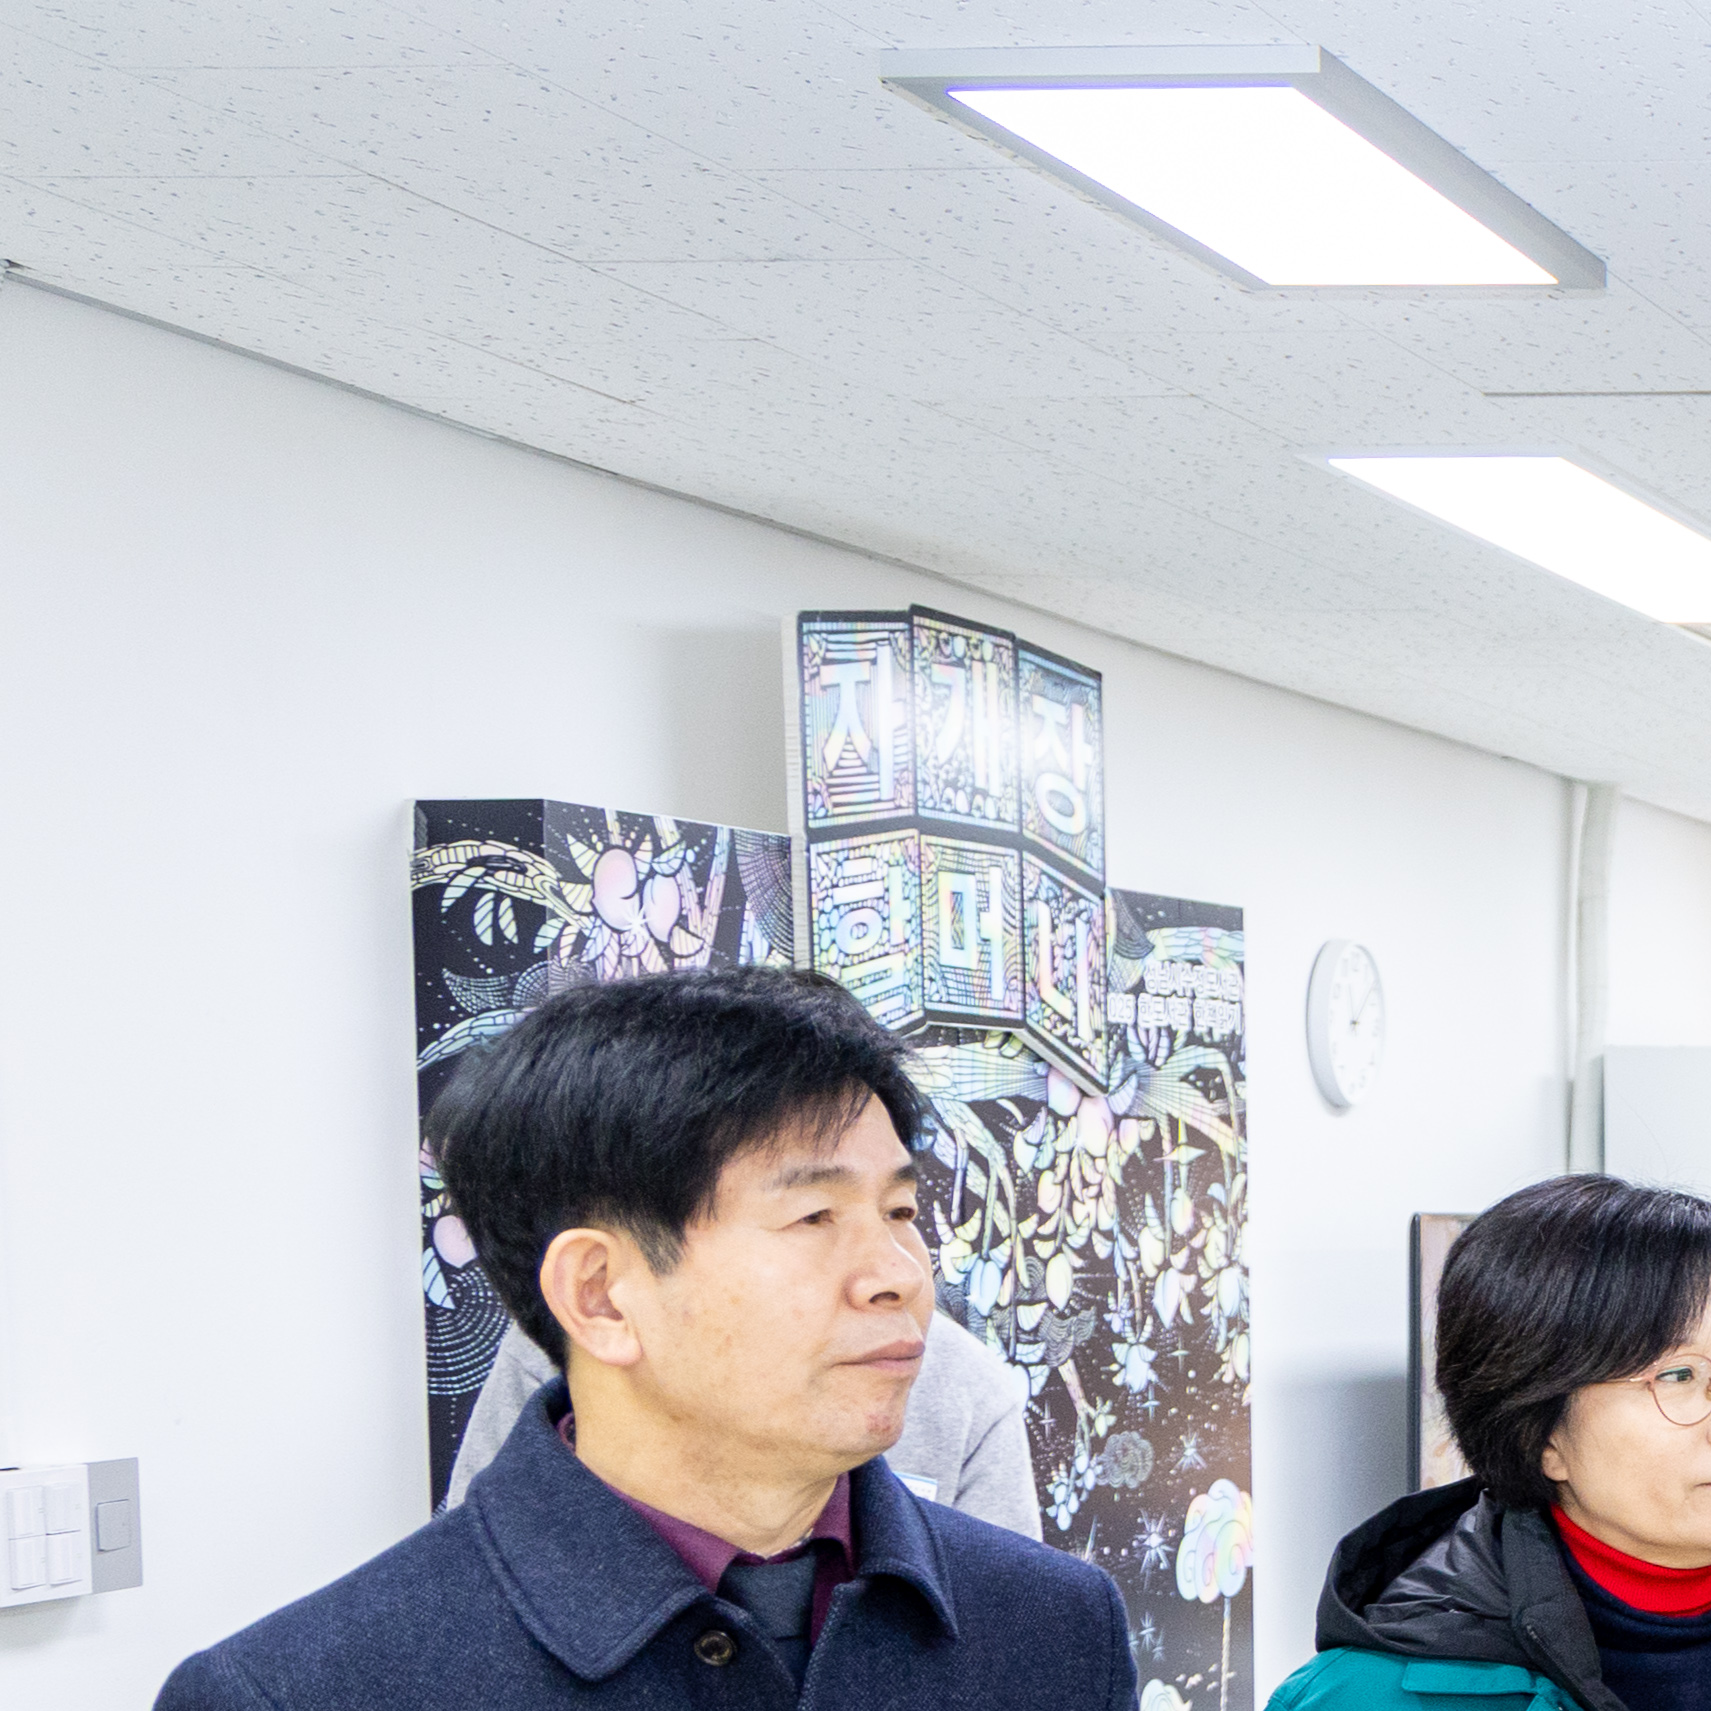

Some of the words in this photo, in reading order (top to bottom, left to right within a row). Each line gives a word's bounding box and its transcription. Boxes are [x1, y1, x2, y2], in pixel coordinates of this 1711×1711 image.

[820, 644, 1094, 836] 자개장
[833, 857, 1092, 1043] 할머니
[1144, 961, 1241, 1001] 성남시수정도서관
[1108, 993, 1136, 1023] 025
